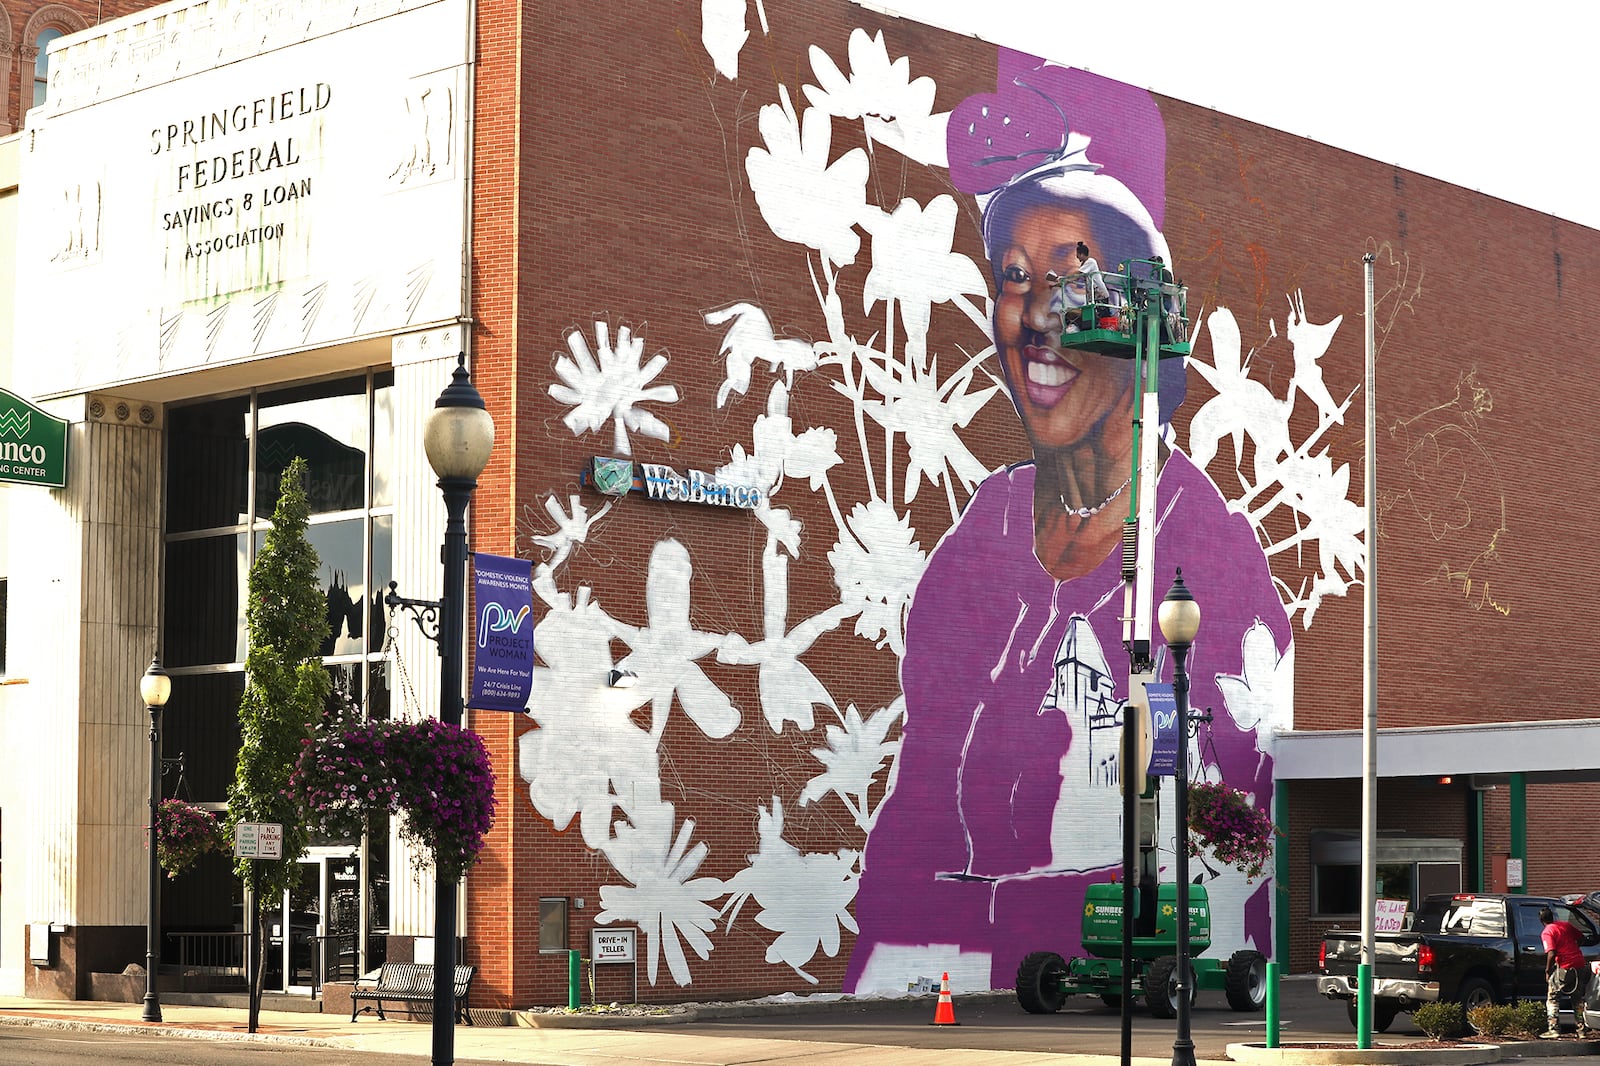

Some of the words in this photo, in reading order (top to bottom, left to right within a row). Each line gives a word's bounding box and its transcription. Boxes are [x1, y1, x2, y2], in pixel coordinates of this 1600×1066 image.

[150, 83, 332, 155] SPRINGFIELD
[178, 137, 300, 192] FEDERAL
[163, 197, 233, 231] SAVINGS
[263, 177, 312, 207] LOAN
[185, 222, 284, 261] ASSOCIATION
[12, 465, 46, 477] CENTER
[640, 463, 762, 510] WesBanco
[475, 569, 504, 580] DOMESTIC
[504, 574, 529, 584] VIOLENCE
[478, 578, 509, 588] AWARENESS
[509, 582, 529, 591] MONTH
[489, 635, 530, 649] PROJECT
[490, 647, 527, 660] WOMAN
[478, 665, 486, 673] We
[498, 668, 509, 676] Here
[510, 669, 518, 677] For
[496, 682, 510, 690] Crisis
[266, 826, 276, 834] NO
[260, 833, 281, 841] PARKING
[1389, 902, 1406, 913] LANE
[1376, 916, 1400, 930] CLOSED
[598, 936, 628, 944] DRIVE-IN
